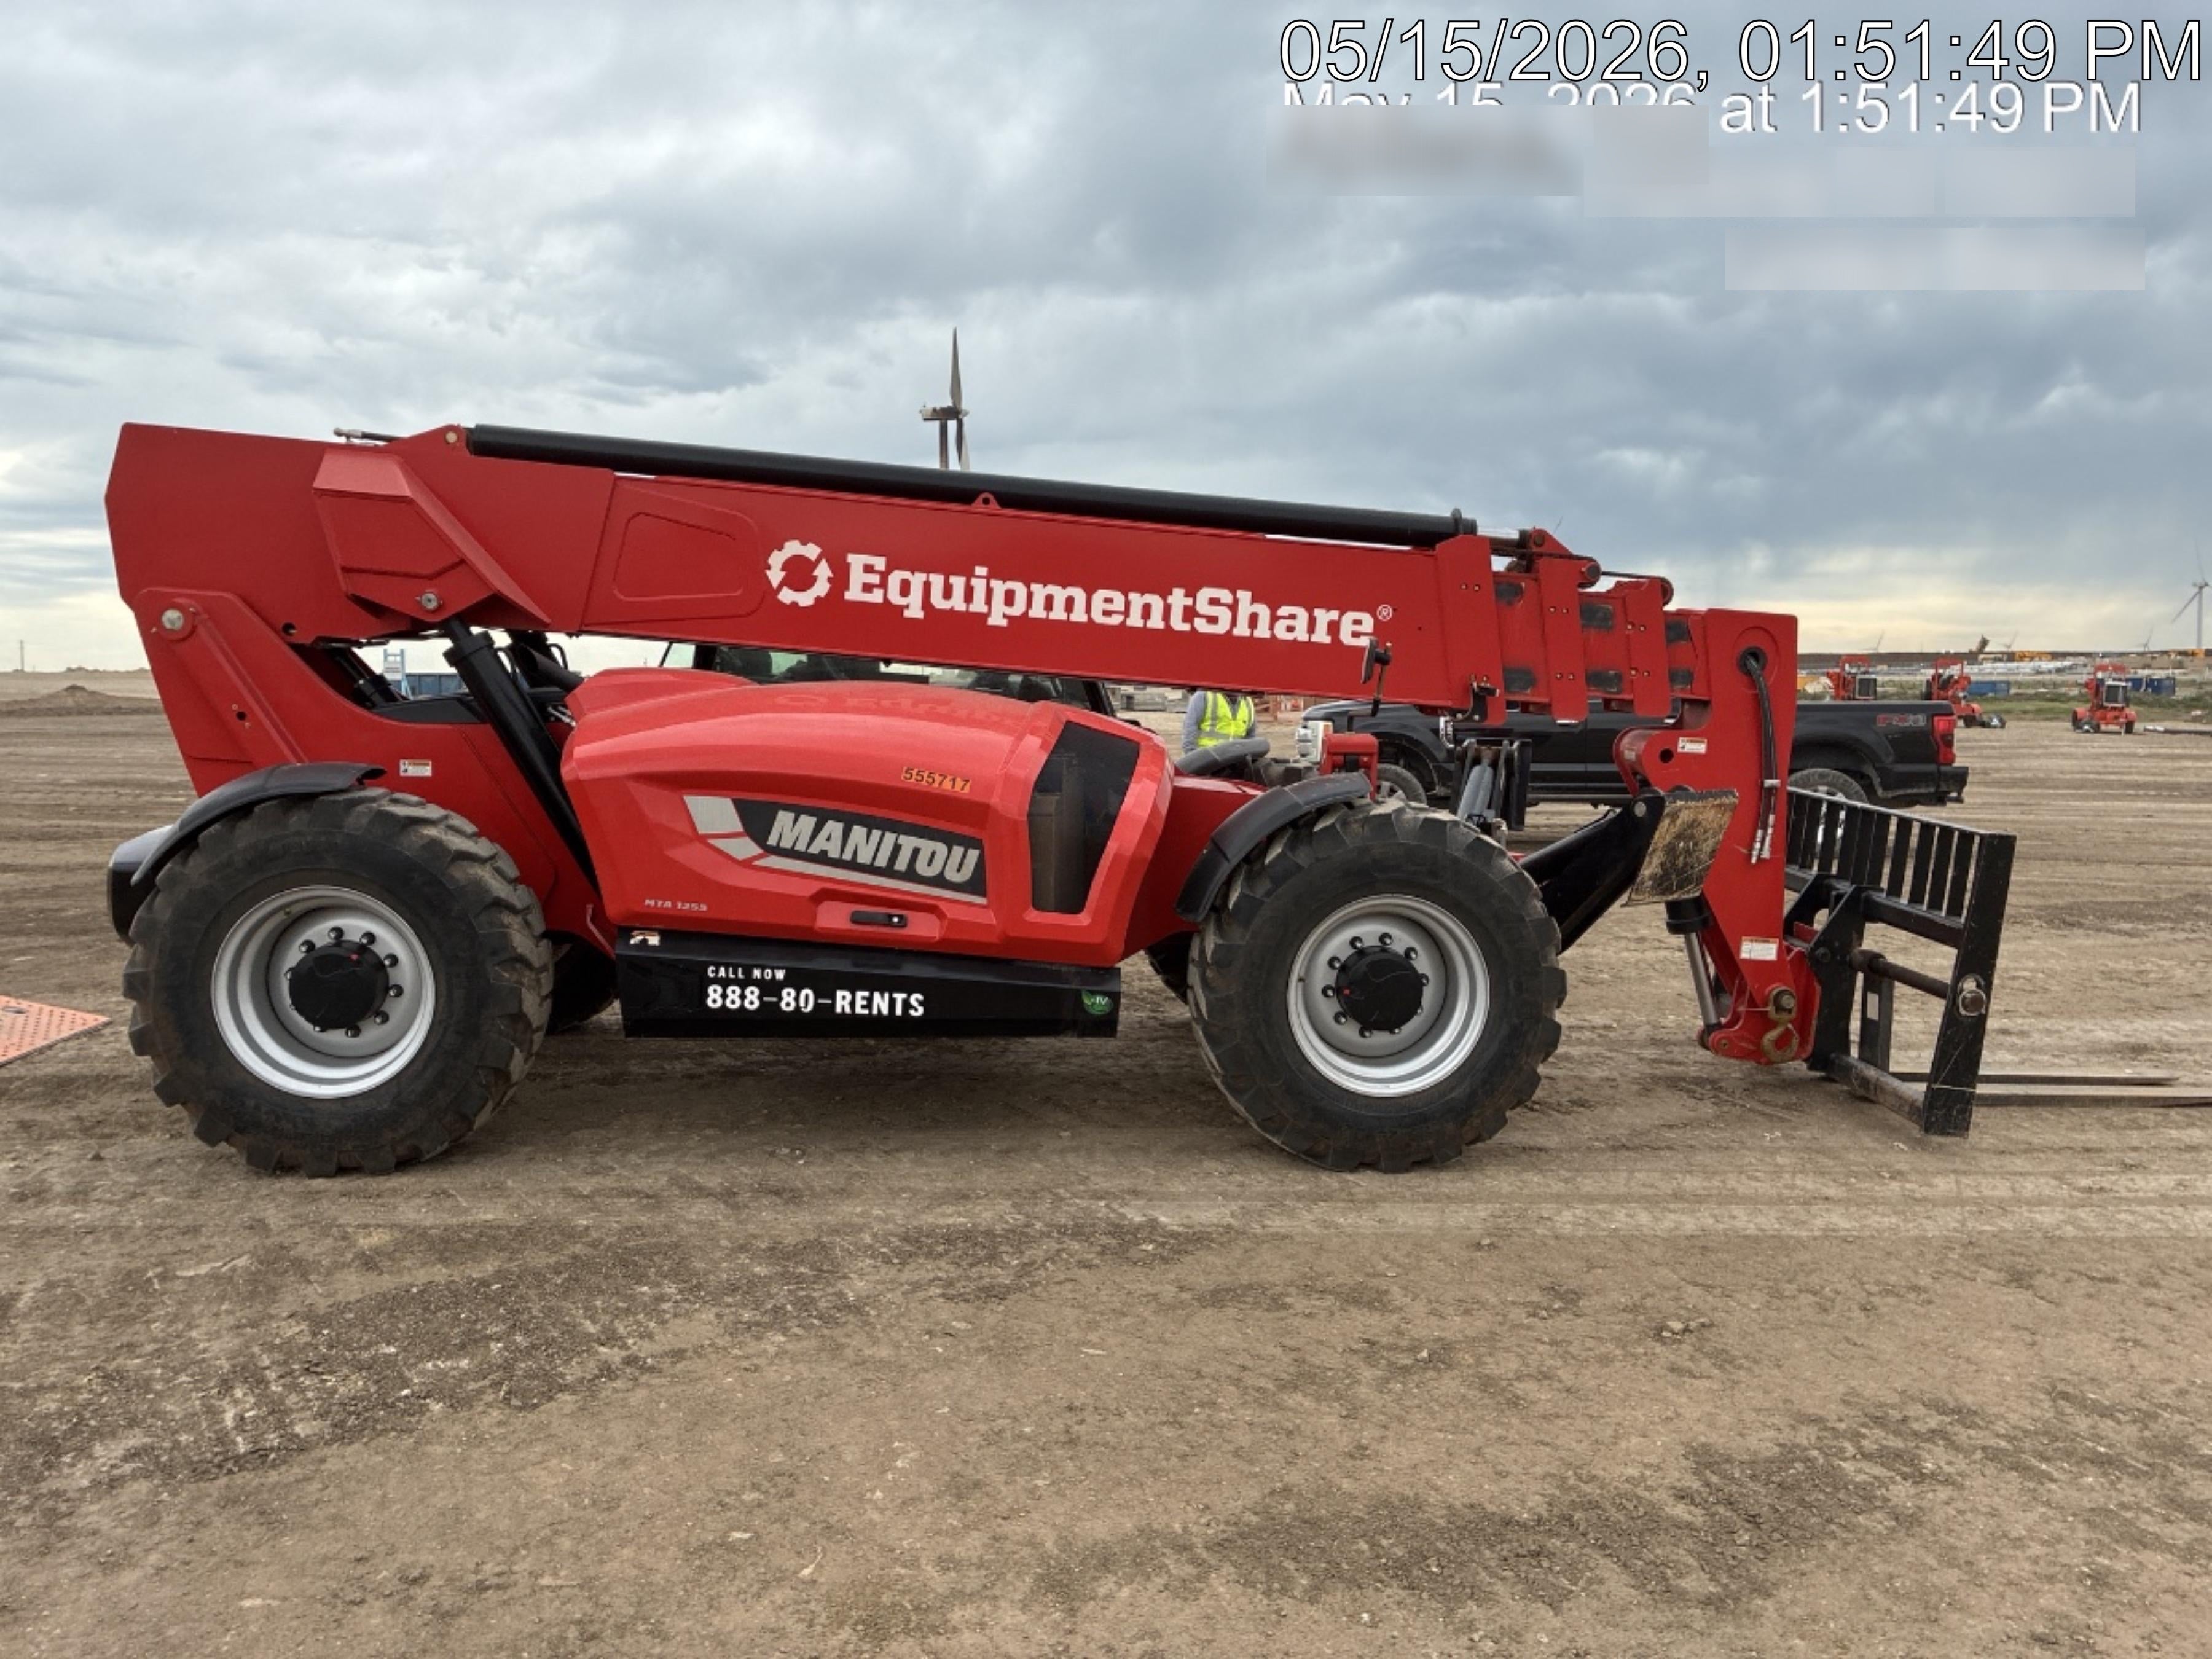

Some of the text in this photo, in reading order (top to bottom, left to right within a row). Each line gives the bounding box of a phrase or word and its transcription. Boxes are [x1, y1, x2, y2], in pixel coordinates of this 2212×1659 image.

[903, 767, 970, 791] 555717
[767, 810, 981, 884] MANITOU
[645, 899, 672, 908] MTA
[707, 966, 785, 981] CALL NOW
[707, 984, 924, 1016] 888-80-RENTS
